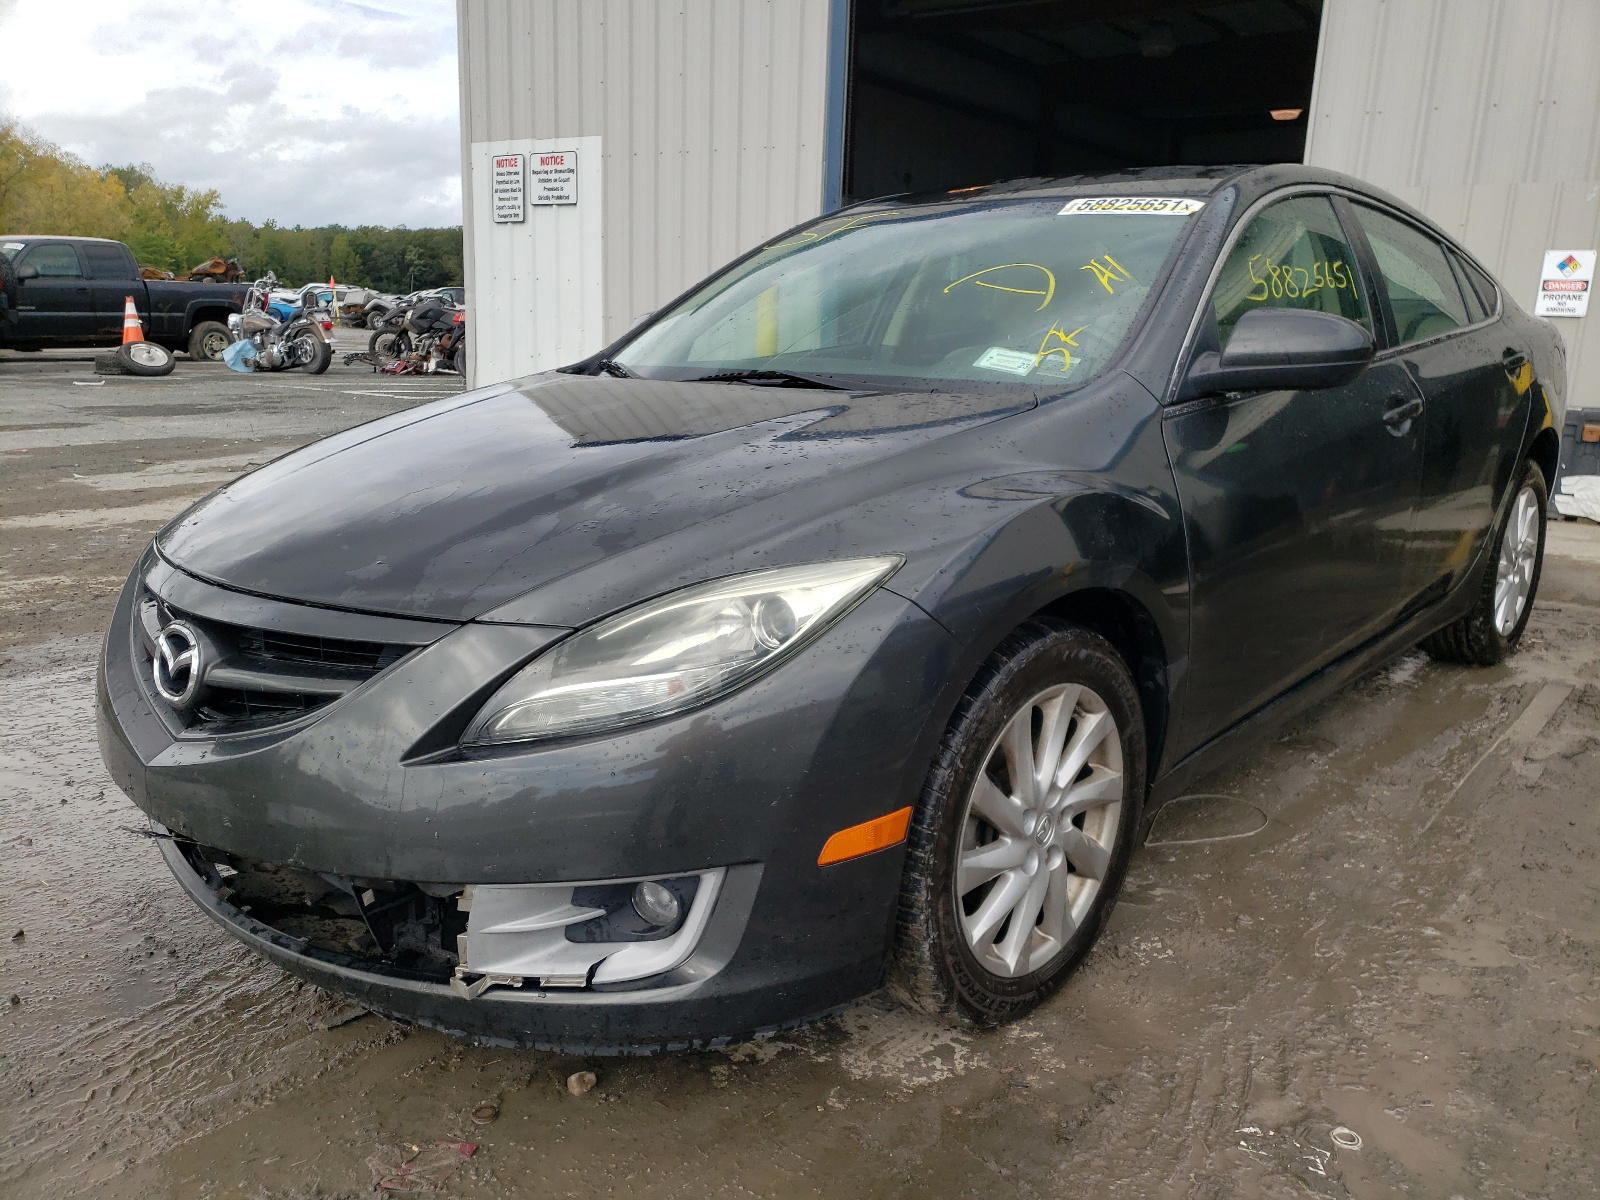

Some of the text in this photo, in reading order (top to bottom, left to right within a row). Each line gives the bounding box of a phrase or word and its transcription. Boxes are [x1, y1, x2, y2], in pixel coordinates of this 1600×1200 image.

[496, 158, 518, 168] NOTICE
[540, 155, 565, 167] NOTICE
[1076, 198, 1183, 211] 58825651
[1246, 254, 1359, 301] 58825651
[1548, 281, 1582, 290] DANGER
[1543, 293, 1584, 301] PROPANE
